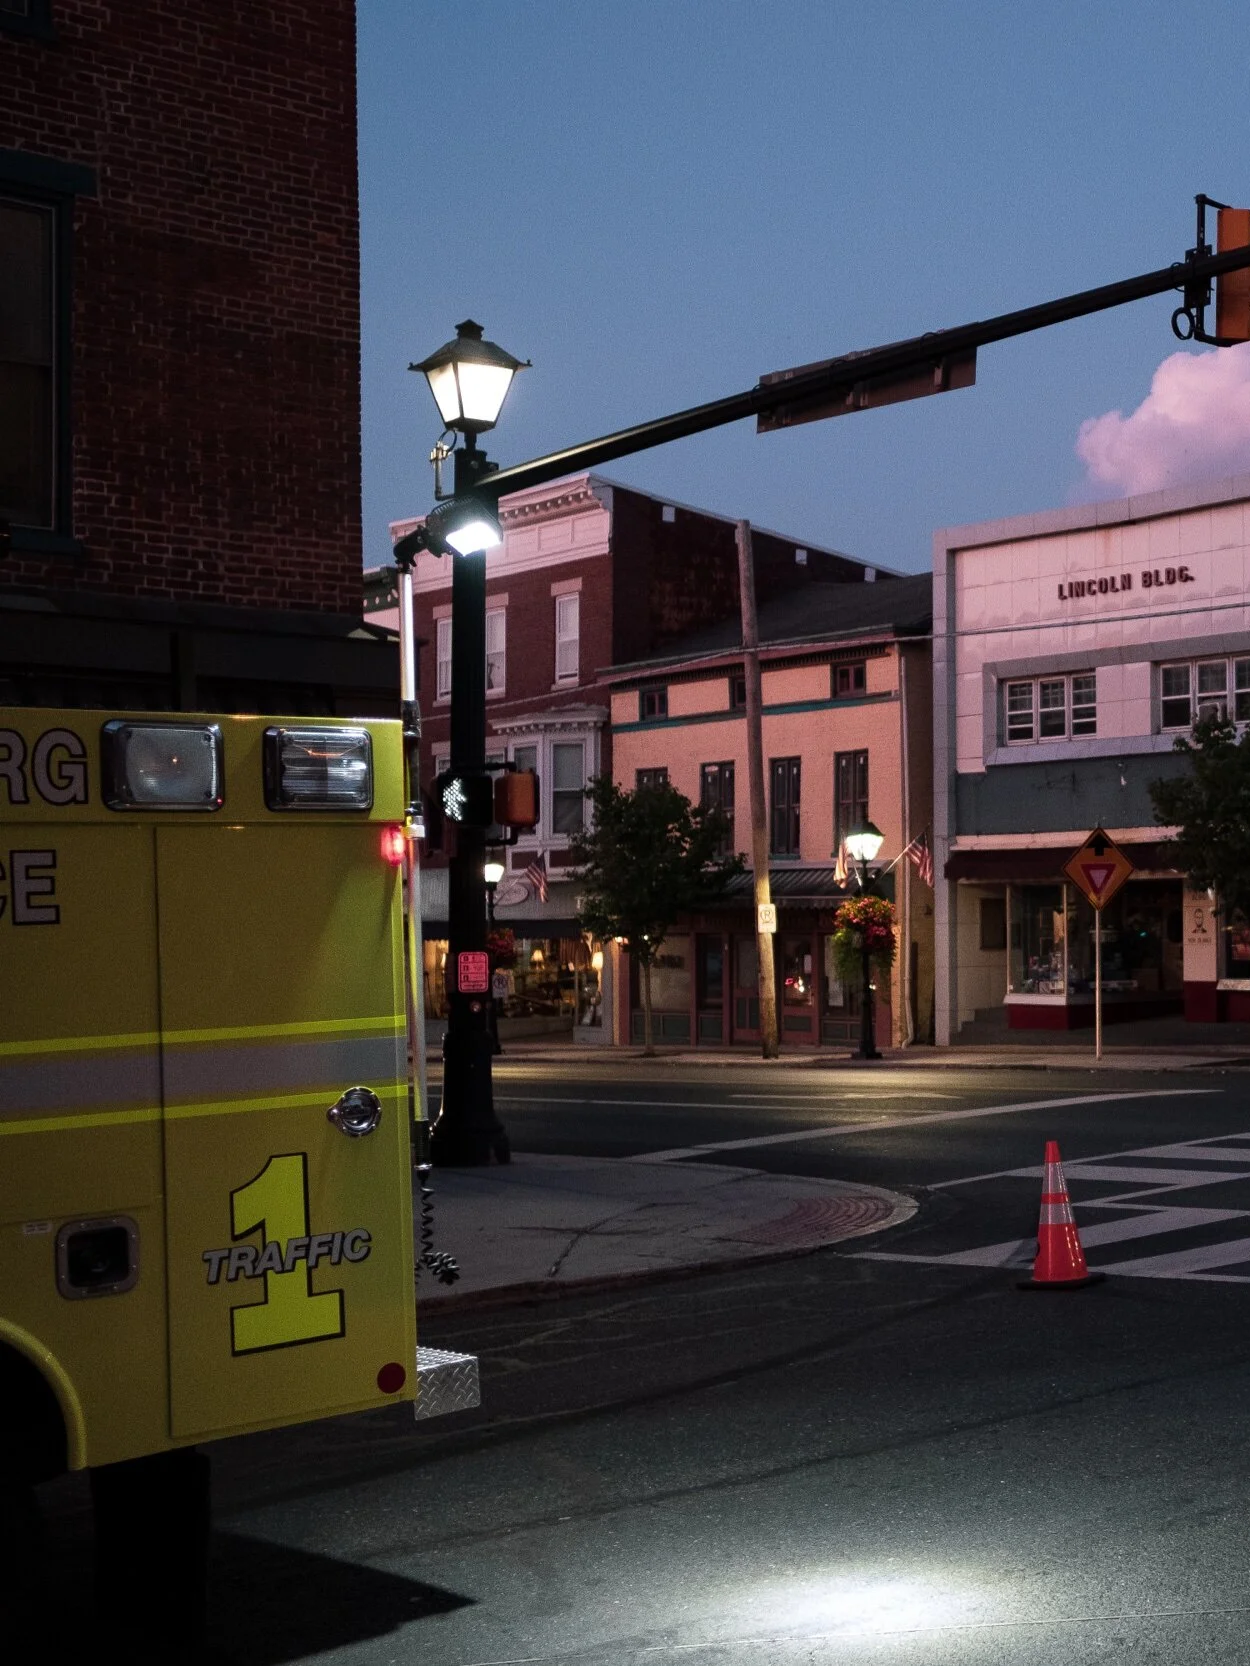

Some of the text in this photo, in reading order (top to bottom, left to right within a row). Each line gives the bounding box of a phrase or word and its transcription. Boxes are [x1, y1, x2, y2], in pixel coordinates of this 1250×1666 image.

[1057, 565, 1195, 601] LINCOLN BLDG.
[0, 849, 61, 926] E
[202, 1227, 373, 1285] TRAFFIC
[230, 1151, 346, 1358] 1
